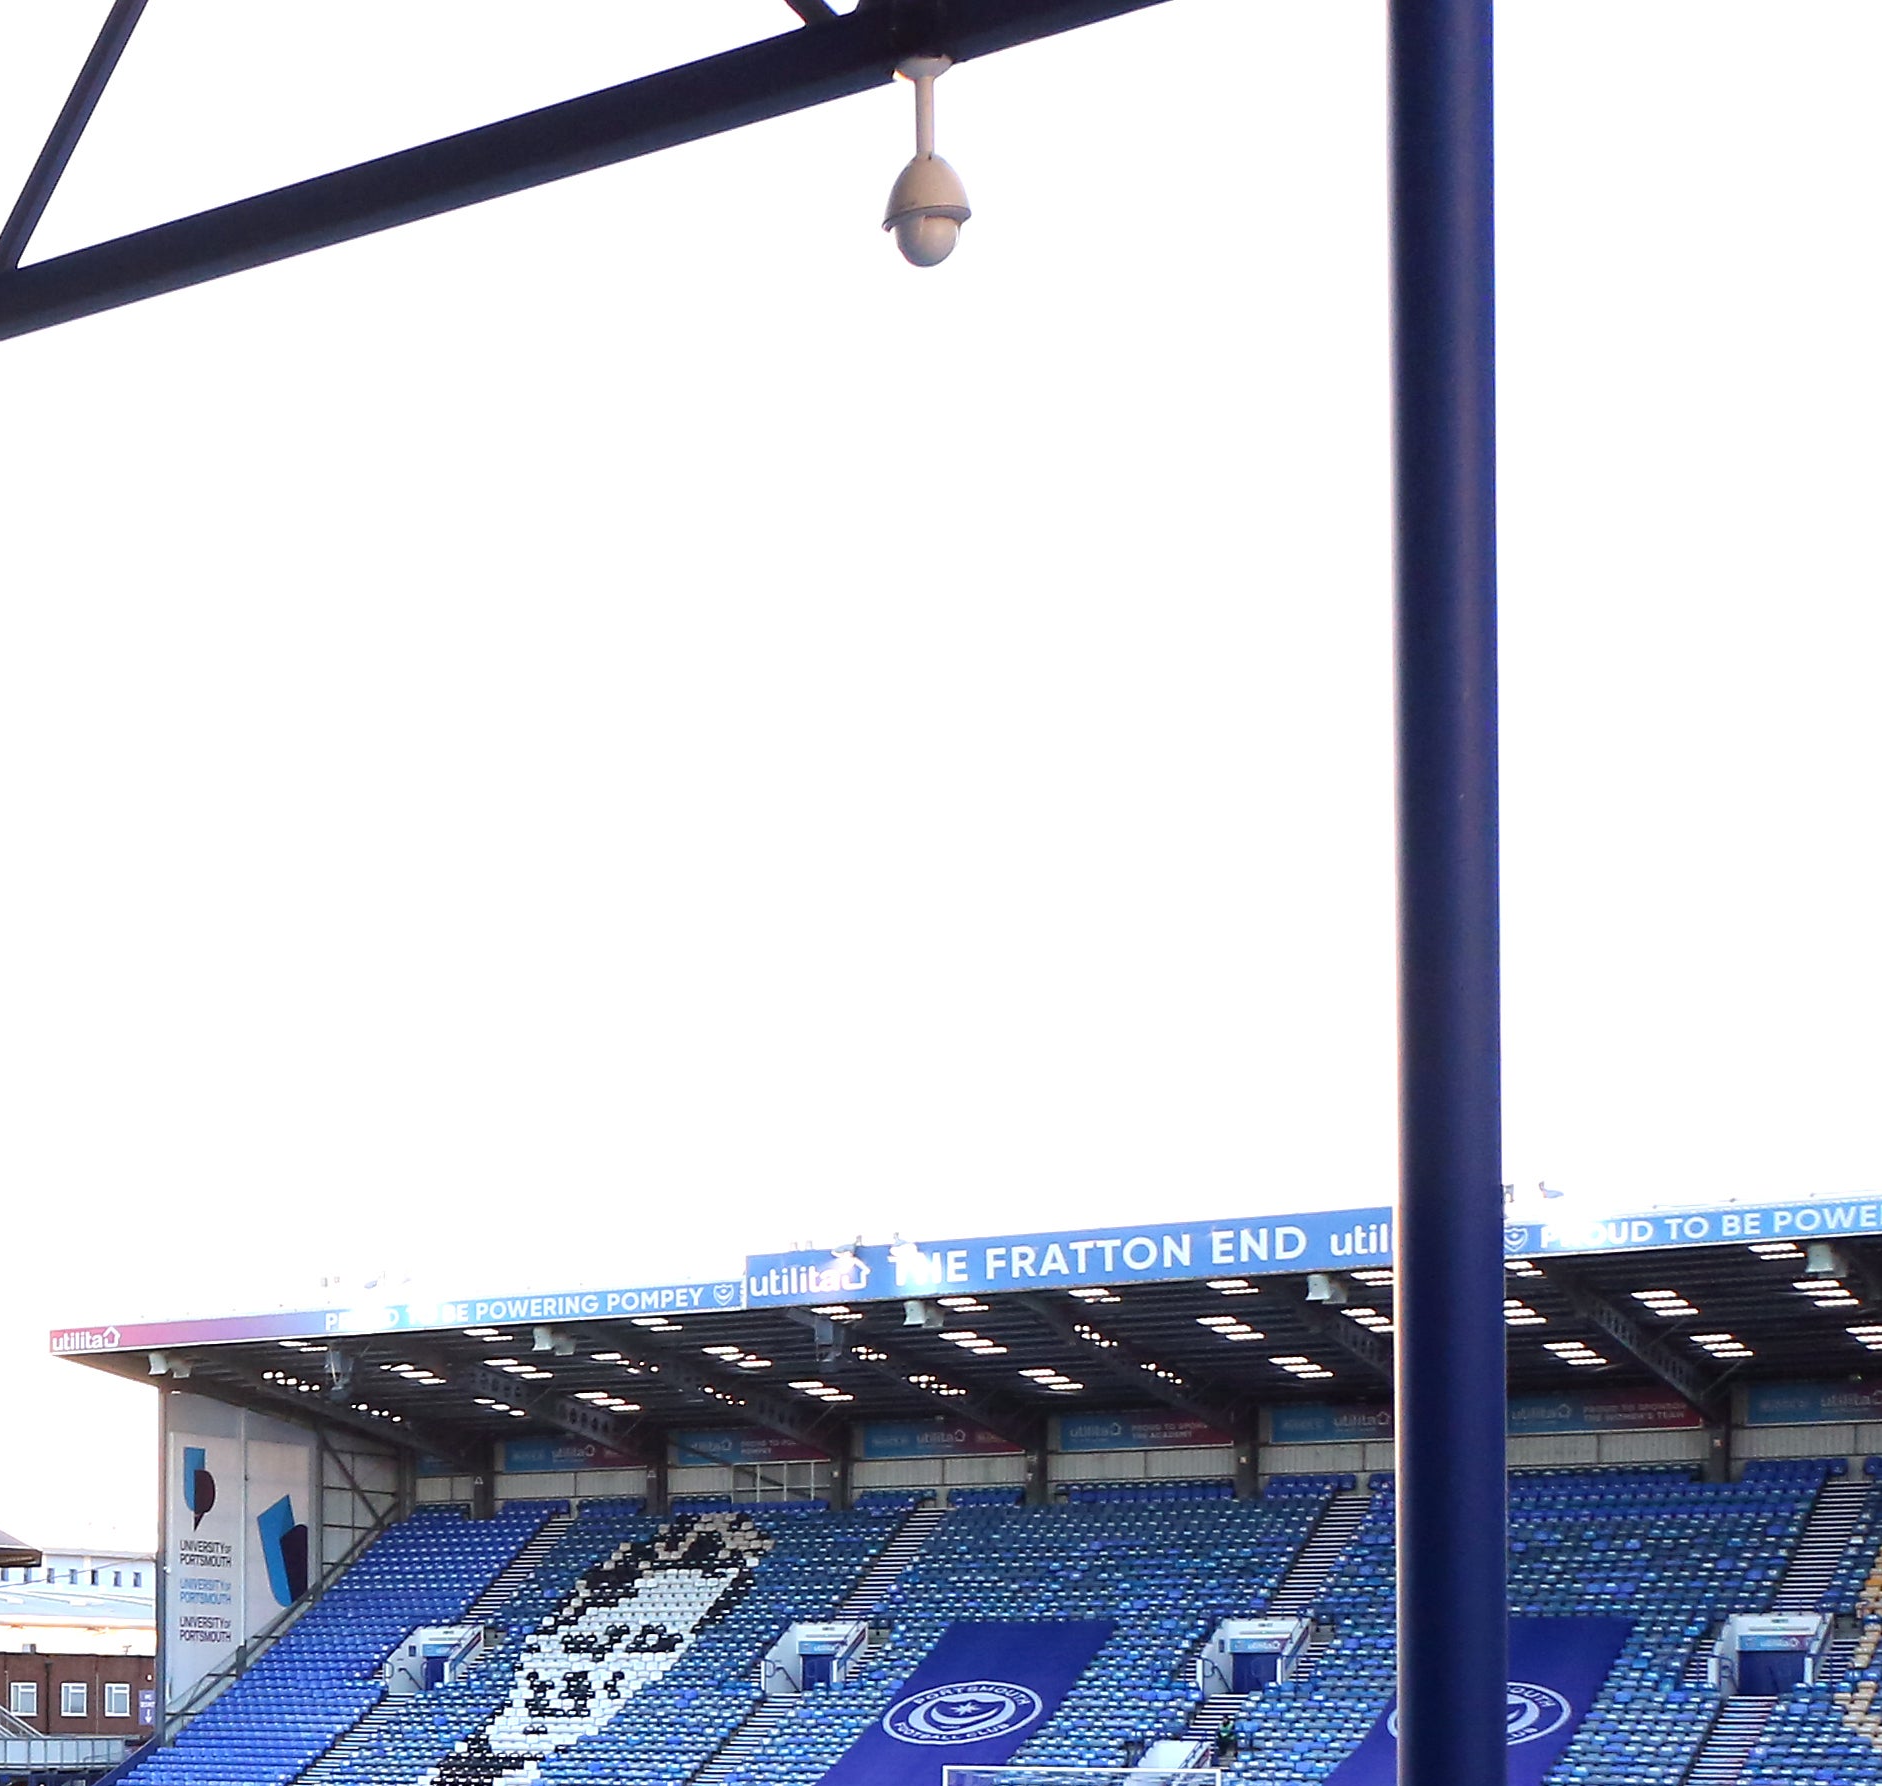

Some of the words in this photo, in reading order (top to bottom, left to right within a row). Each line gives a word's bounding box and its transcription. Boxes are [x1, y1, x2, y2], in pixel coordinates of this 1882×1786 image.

[1665, 1217, 1708, 1240] TO
[1722, 1213, 1761, 1237] BE
[1773, 1205, 1882, 1232] POWE
[749, 1263, 836, 1298] utilita
[987, 1233, 1191, 1281] FRATTON
[1211, 1226, 1308, 1265] END
[476, 1294, 600, 1320] POWERING
[607, 1287, 704, 1311] POMPEY
[51, 1331, 103, 1351] utilita
[180, 1541, 224, 1553] UNIVERSITY
[180, 1555, 232, 1567] PORTSMOUTH
[180, 1617, 224, 1629] UNIVERSITY
[180, 1631, 232, 1643] PORTSMOUTH
[913, 1686, 1031, 1705] PORTSMOUTH
